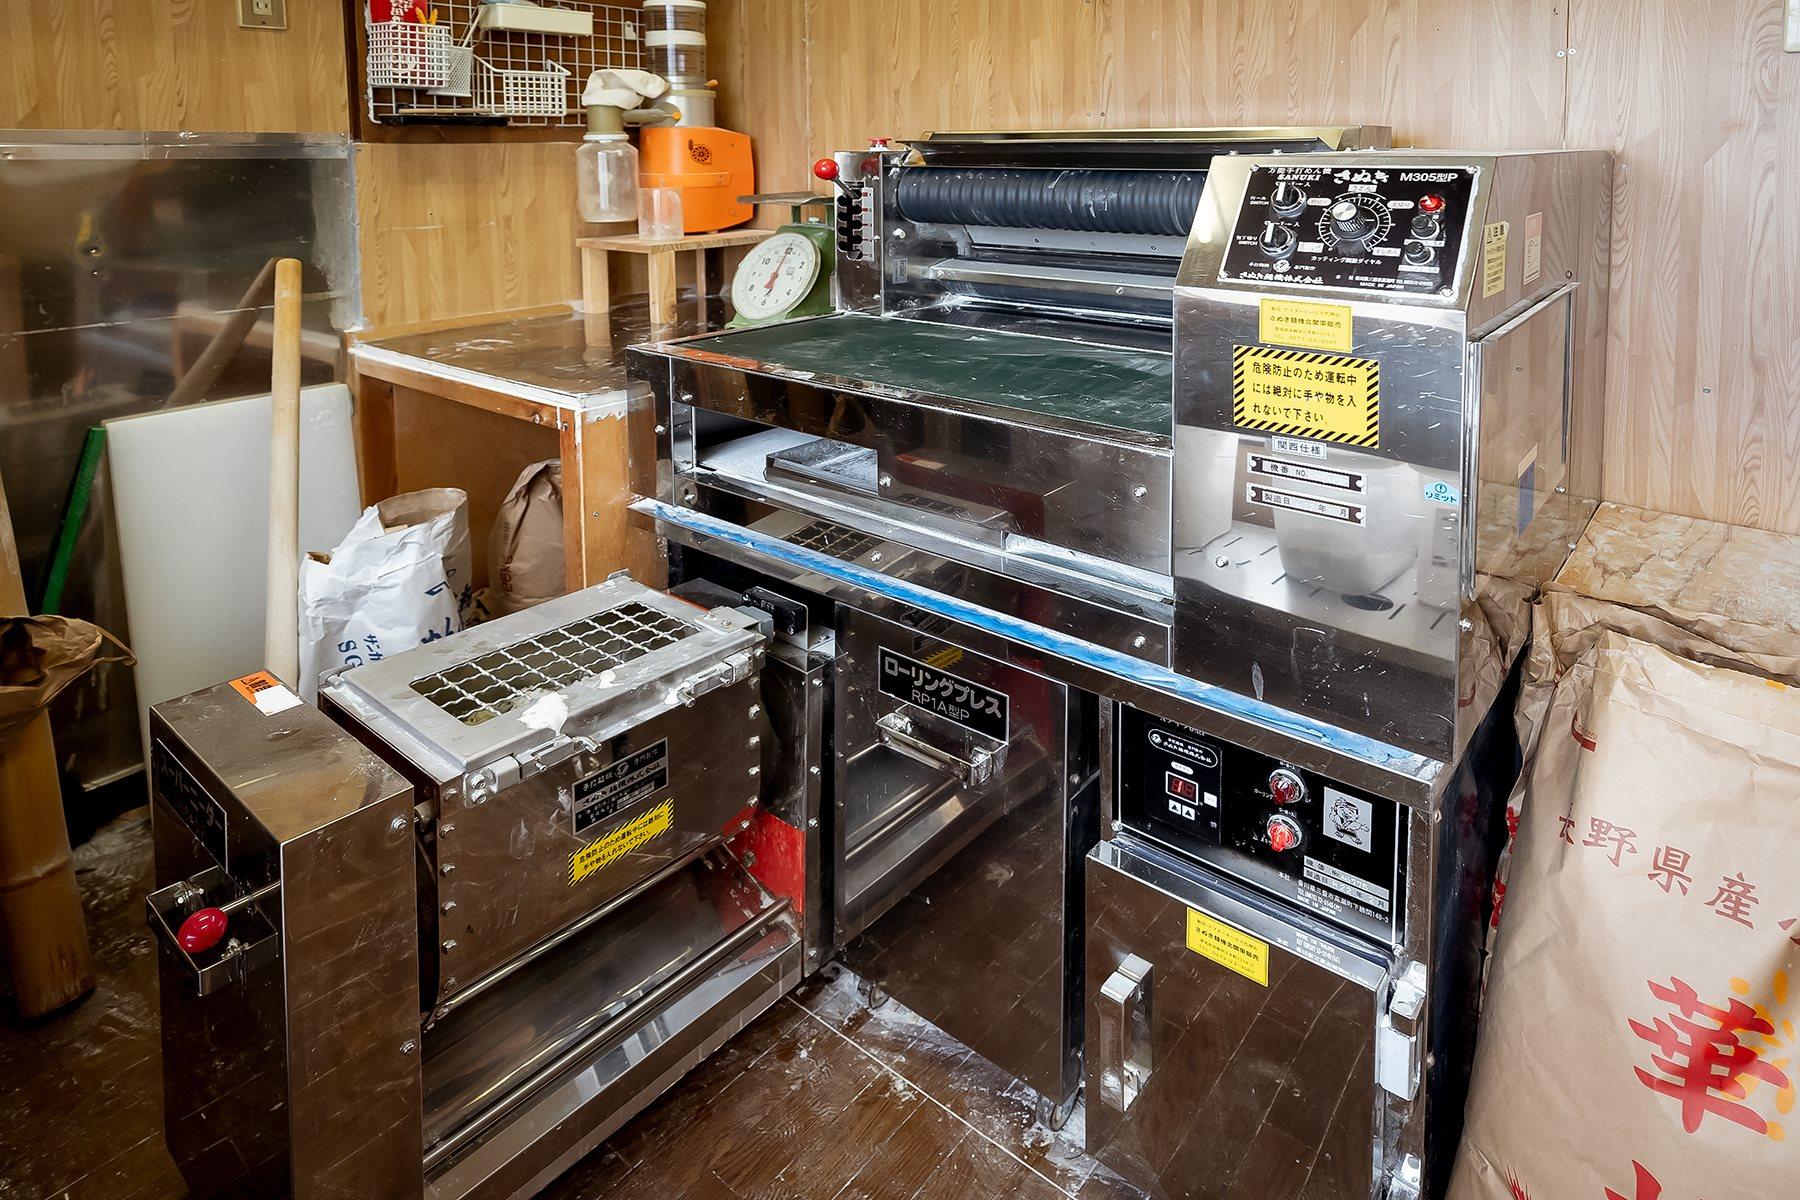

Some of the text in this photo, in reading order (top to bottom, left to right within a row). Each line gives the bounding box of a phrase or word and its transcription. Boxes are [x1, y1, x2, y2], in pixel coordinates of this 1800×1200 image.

[1332, 169, 1390, 184] さぬき
[1400, 172, 1458, 182] M305型P
[761, 257, 771, 265] 10
[798, 261, 805, 269] 2
[748, 284, 755, 292] 8
[785, 288, 792, 296] 4
[760, 298, 767, 306] 6
[1252, 361, 1357, 386] 危険防止のため運転中
[1252, 382, 1357, 408] には絶対に手や物を入
[1277, 440, 1321, 455] 関西仕様
[1270, 463, 1308, 478] 機番 NO.
[1264, 492, 1290, 505] 製造日
[1425, 491, 1457, 503] リミット
[884, 656, 1002, 719] ローリングプレス
[911, 689, 970, 721] RP1A型P
[1627, 975, 1790, 1134] 華
